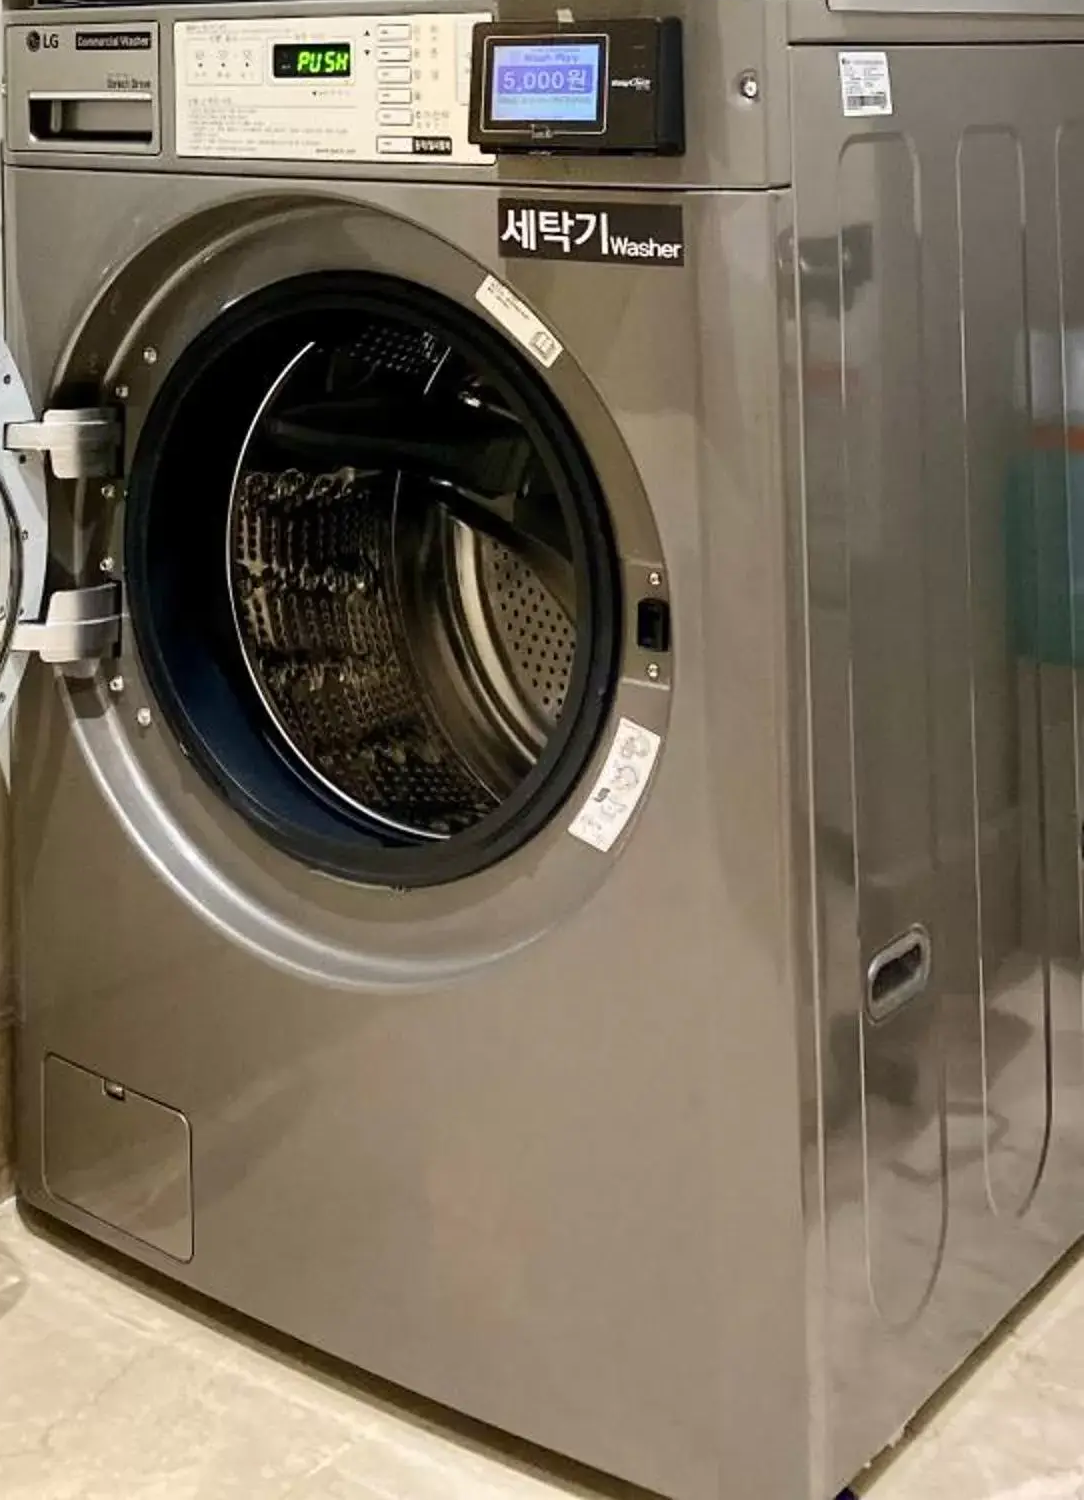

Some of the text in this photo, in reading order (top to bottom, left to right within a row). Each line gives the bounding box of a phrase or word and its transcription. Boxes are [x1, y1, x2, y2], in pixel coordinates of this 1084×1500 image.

[43, 33, 59, 49] LG
[297, 51, 349, 73] PUSH
[503, 69, 586, 92] 5,000원
[501, 209, 682, 259] 세탁기 Washer
